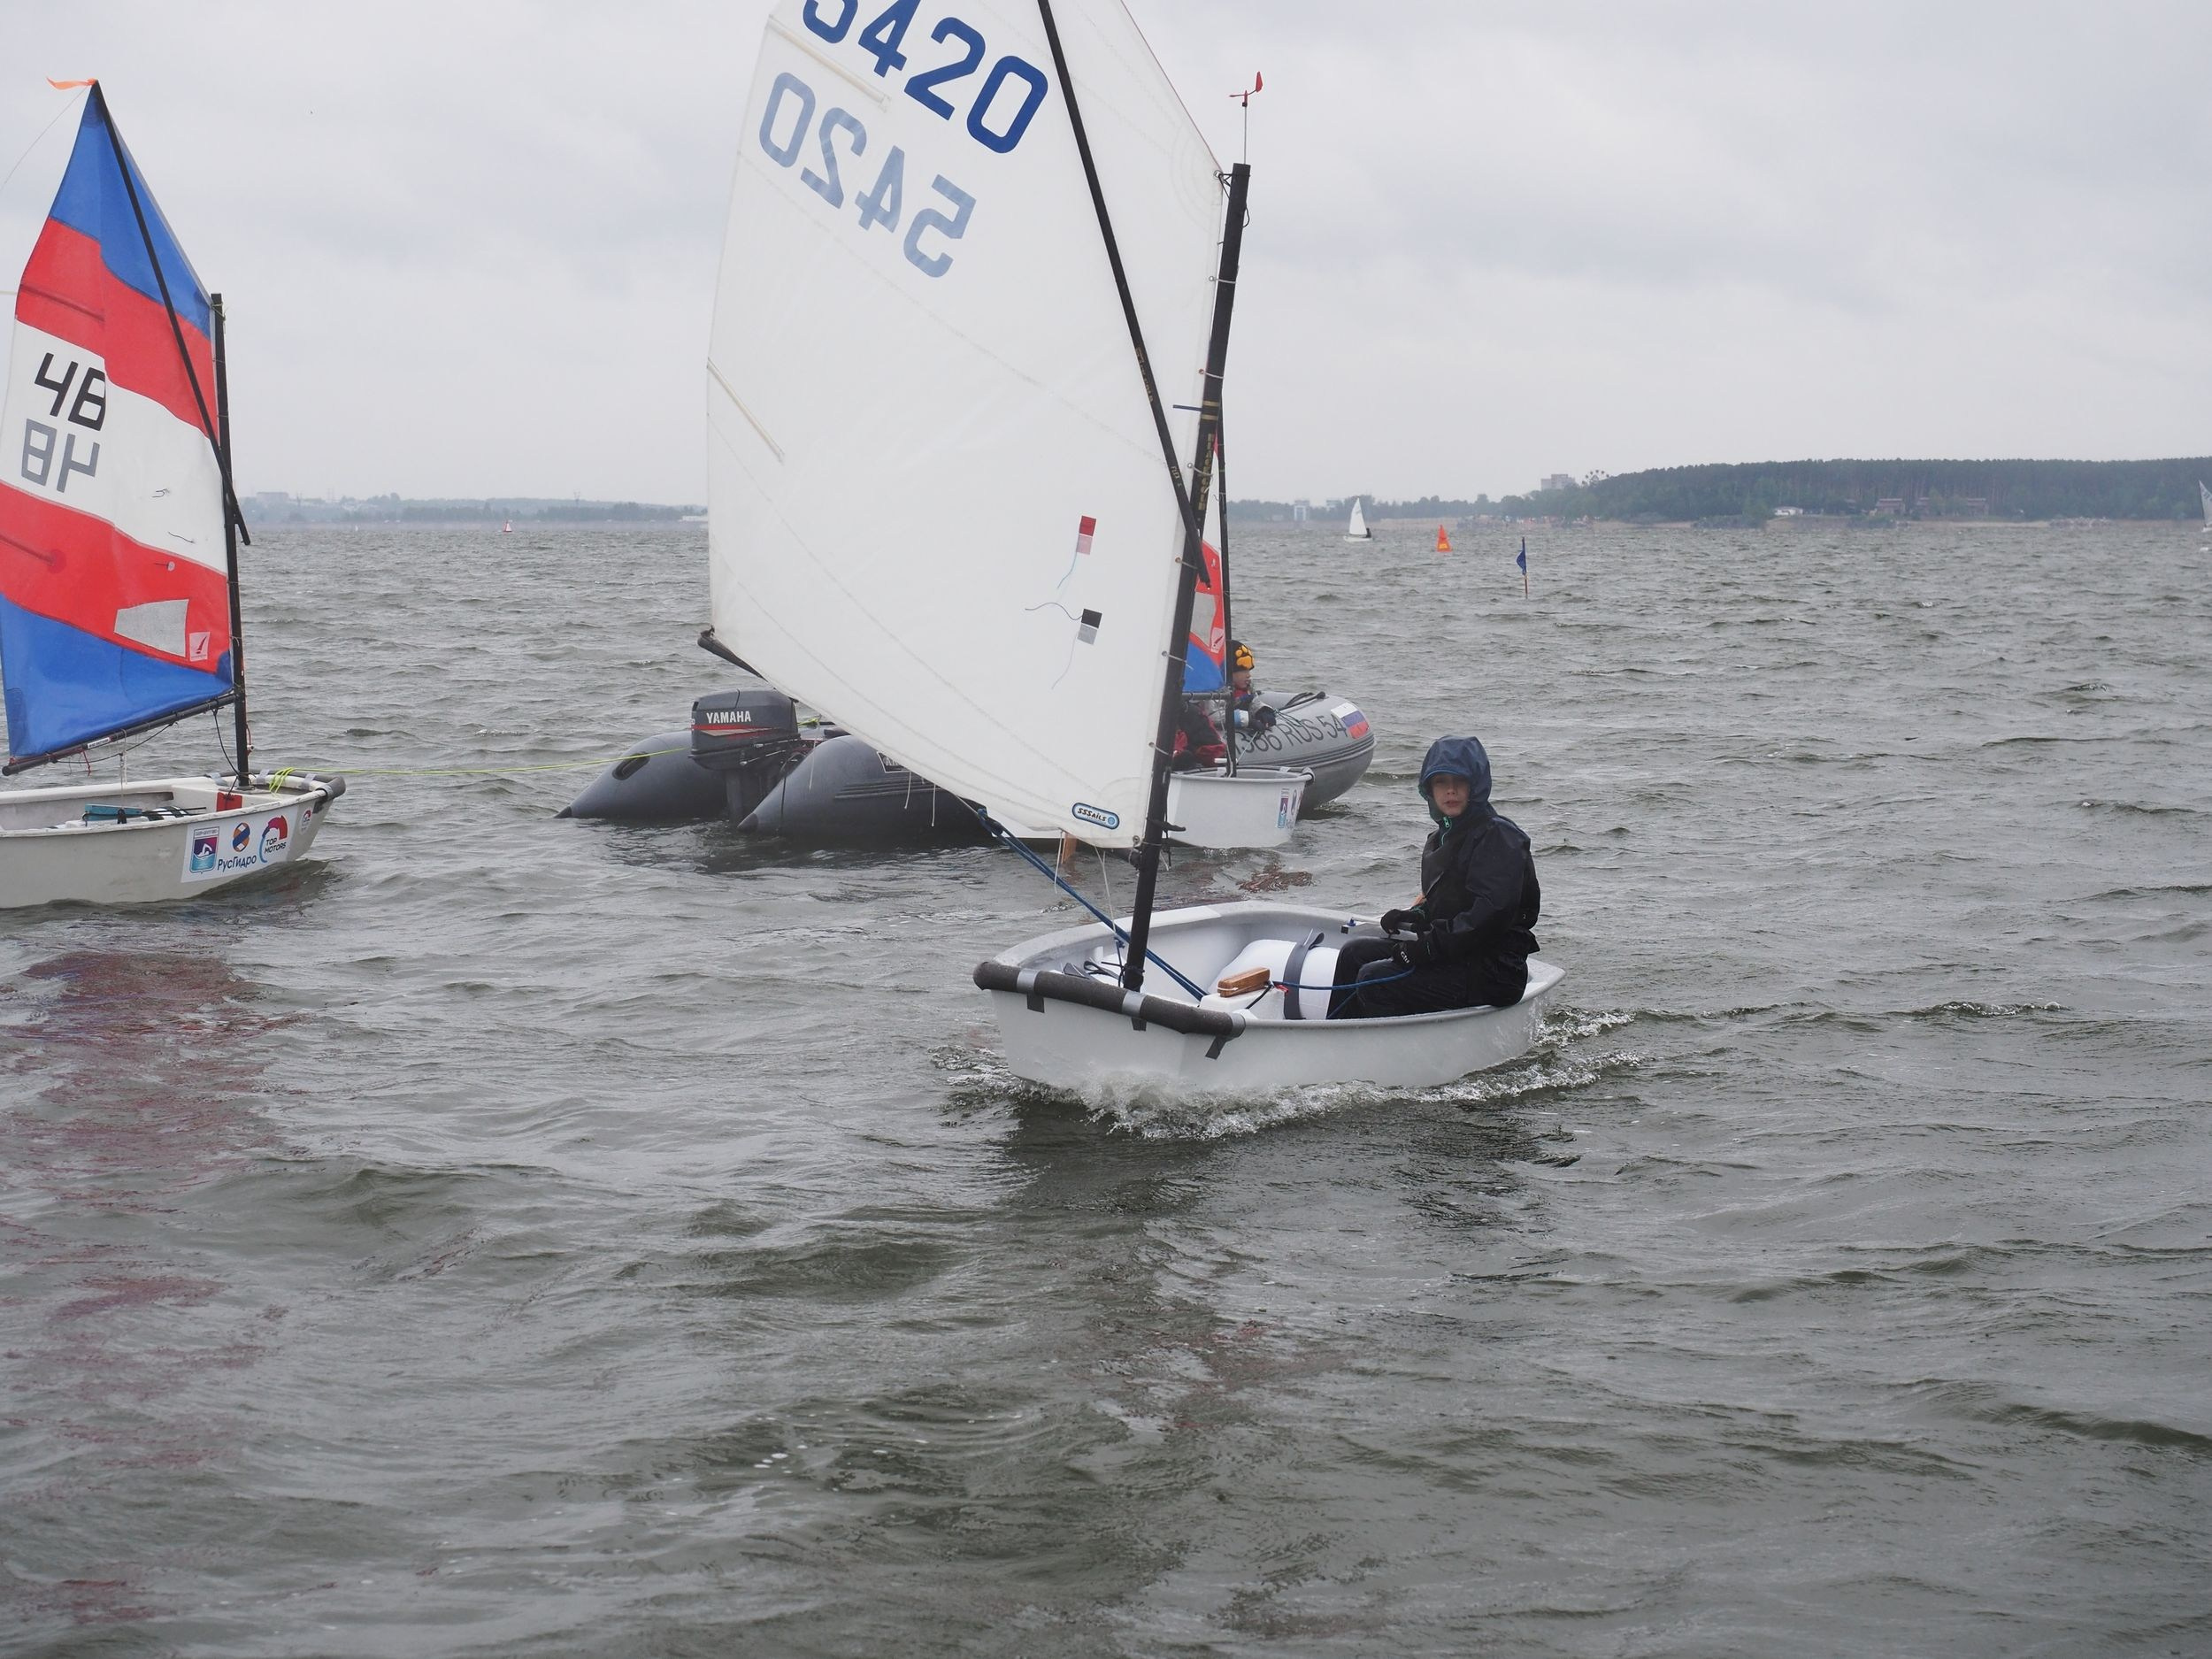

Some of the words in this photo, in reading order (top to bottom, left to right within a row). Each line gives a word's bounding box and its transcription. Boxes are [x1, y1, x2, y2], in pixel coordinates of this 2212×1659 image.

[706, 710, 751, 724] YAMAHA
[1275, 718, 1325, 747] RUS
[1316, 713, 1348, 739] 54
[265, 837, 278, 846] TOP
[265, 841, 287, 854] MOTORS
[217, 855, 257, 872] РусГидро
